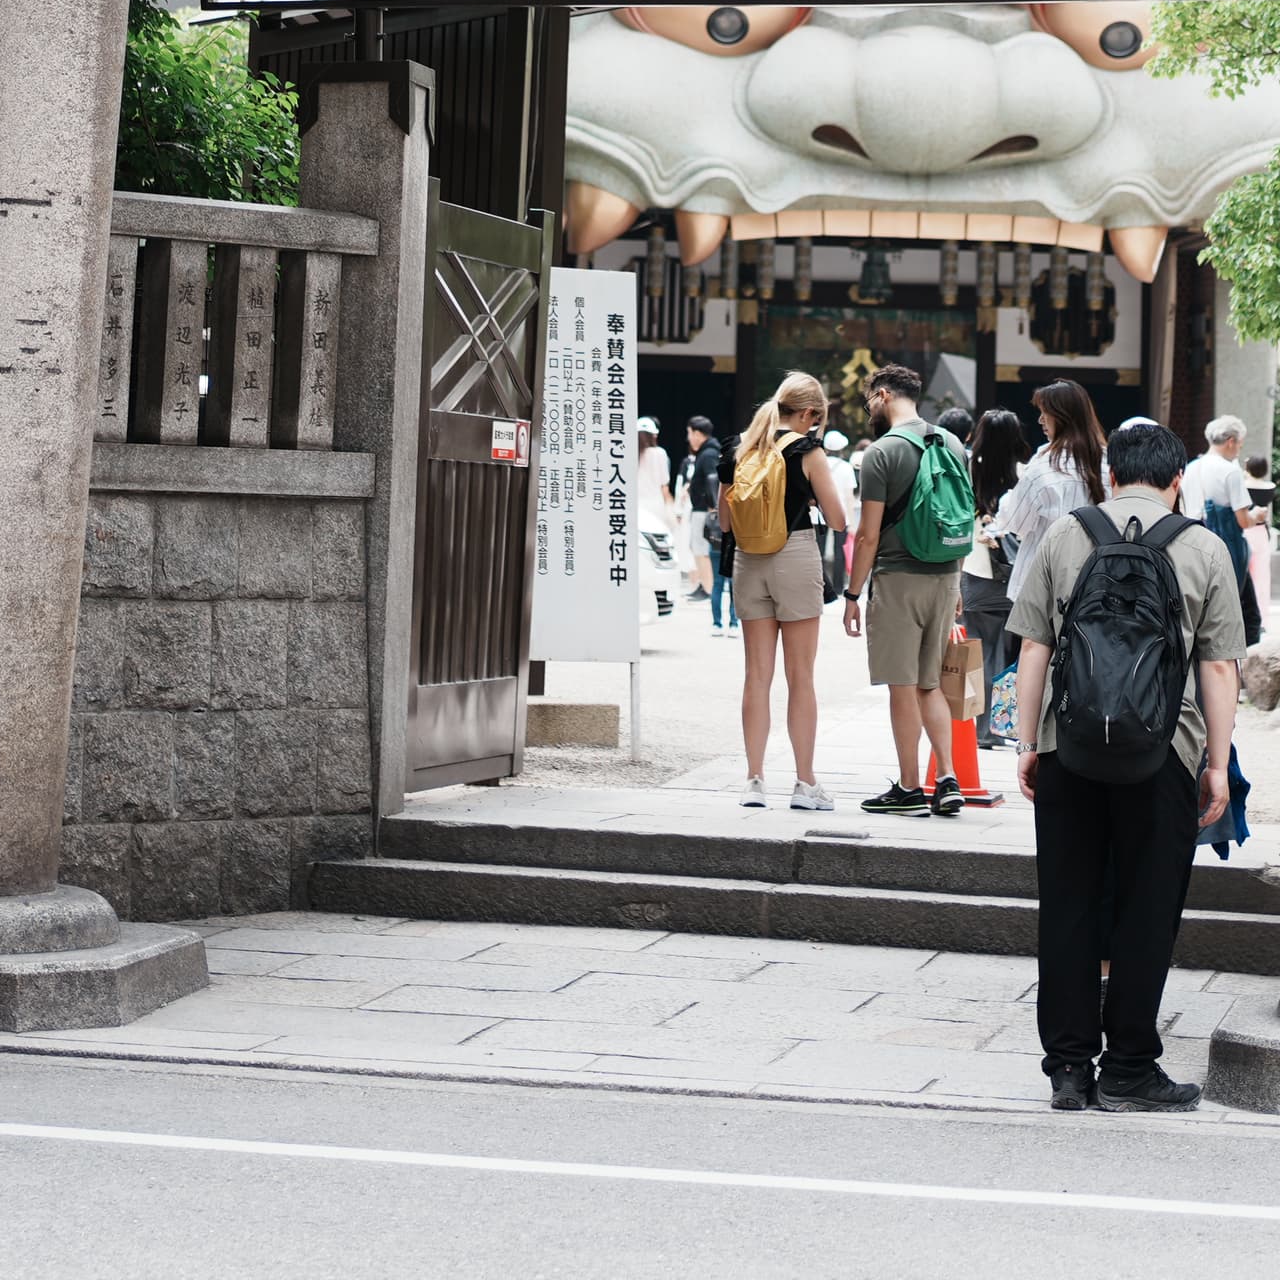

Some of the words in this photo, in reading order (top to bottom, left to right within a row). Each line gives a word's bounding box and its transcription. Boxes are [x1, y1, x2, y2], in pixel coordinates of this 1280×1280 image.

[607, 313, 627, 587] 奉賛会会員ご入会受付中
